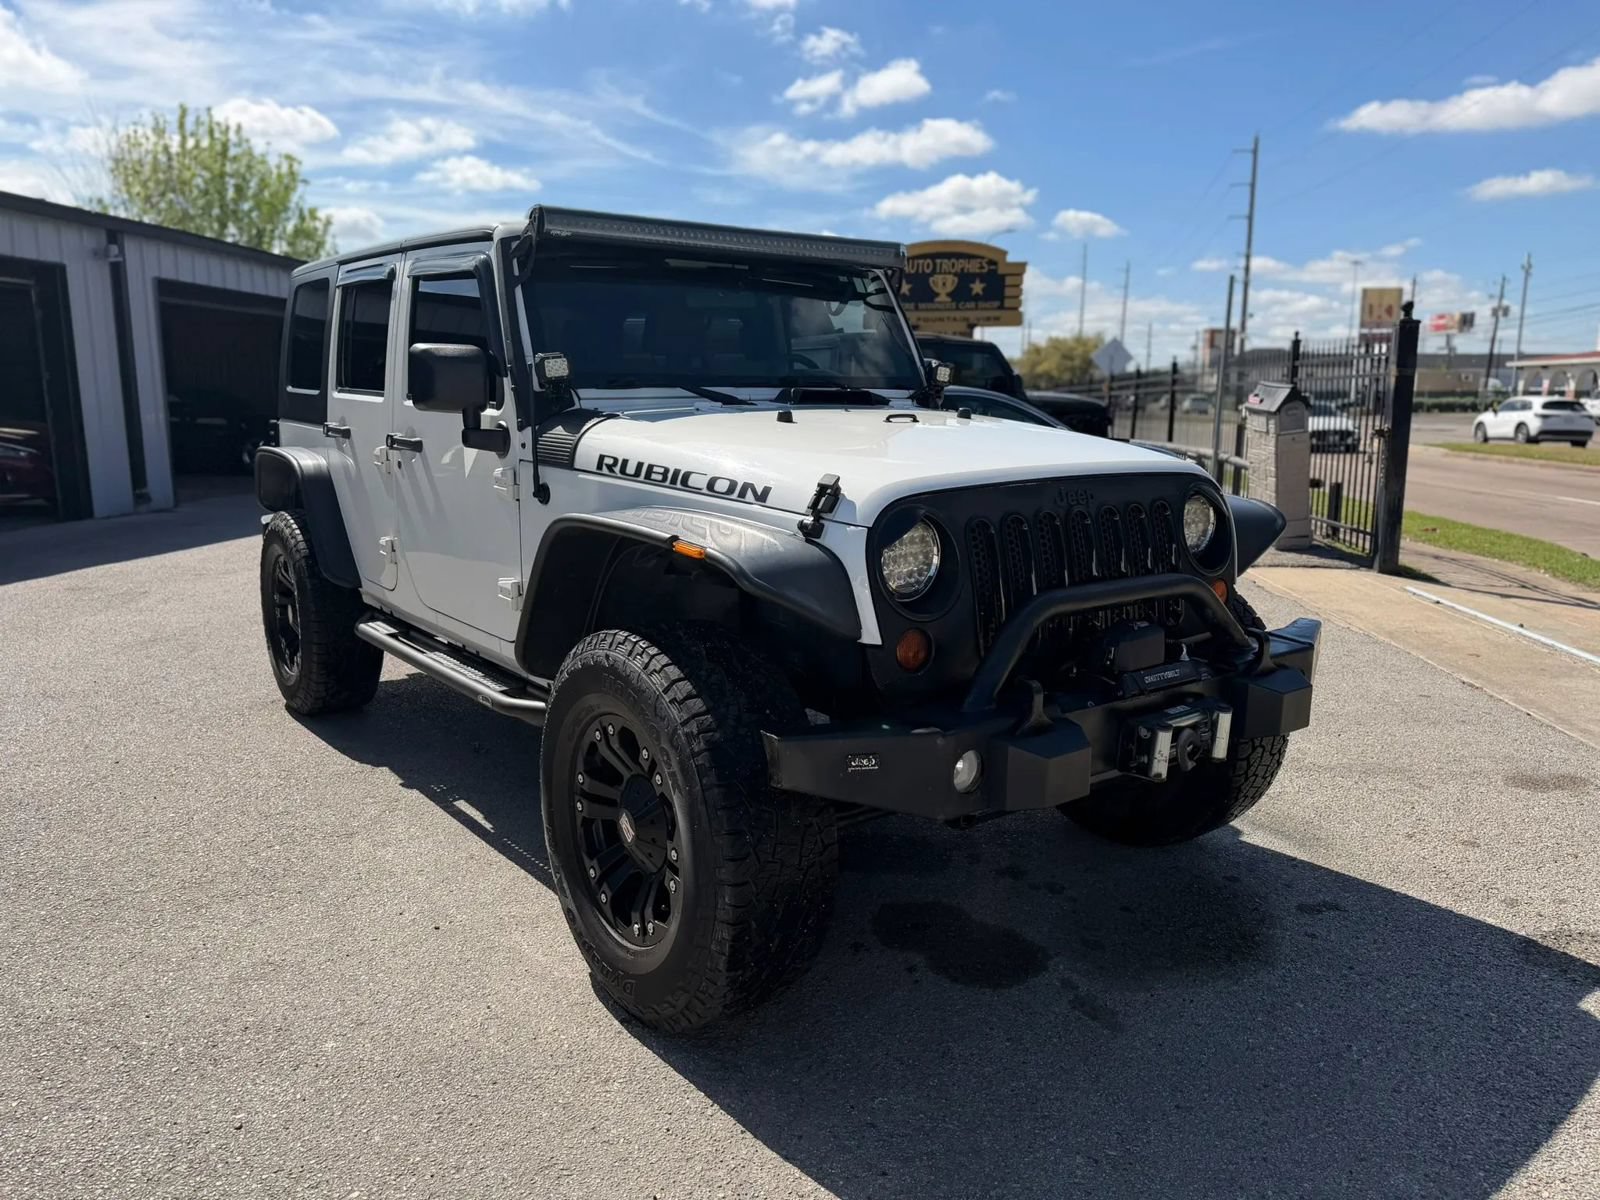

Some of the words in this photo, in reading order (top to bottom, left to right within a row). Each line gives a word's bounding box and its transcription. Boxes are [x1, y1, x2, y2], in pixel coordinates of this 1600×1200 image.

[903, 258, 933, 274] AUTO
[935, 258, 989, 274] TROPHIES
[595, 453, 773, 504] RUBICON
[1056, 487, 1096, 507] Jeep
